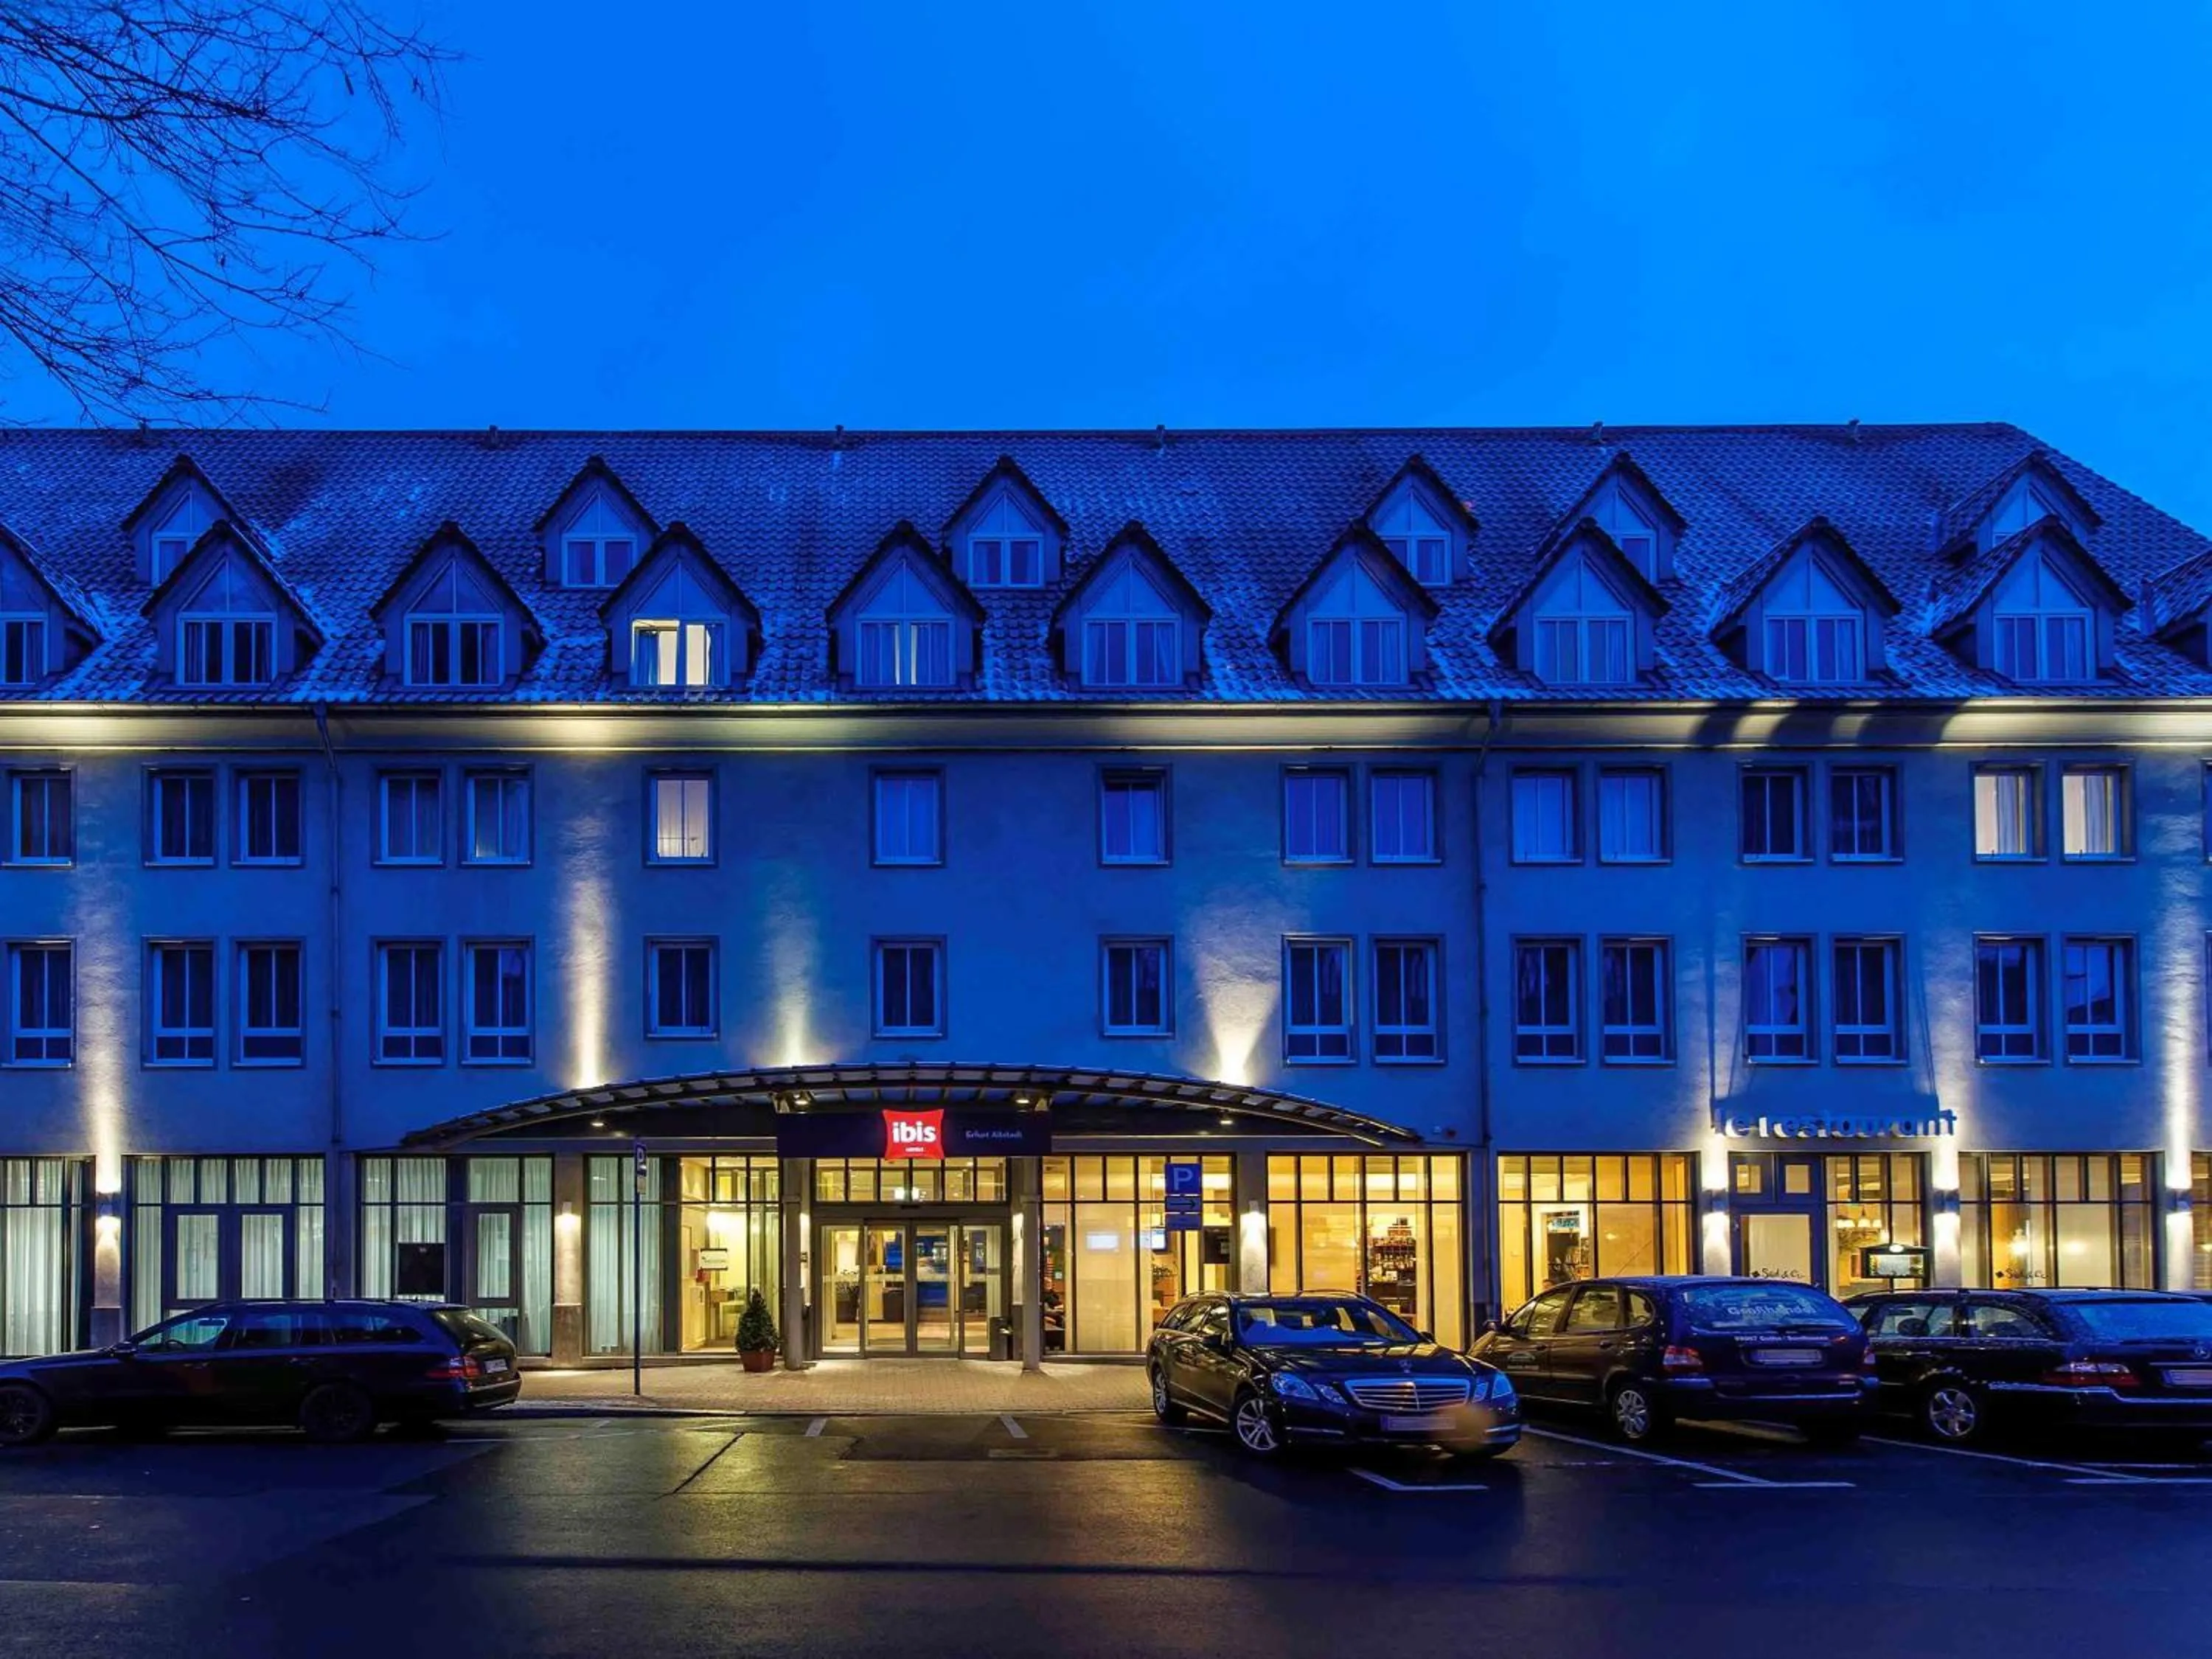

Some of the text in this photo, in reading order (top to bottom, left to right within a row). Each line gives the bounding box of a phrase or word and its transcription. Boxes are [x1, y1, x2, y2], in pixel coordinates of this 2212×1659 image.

[892, 1121, 936, 1143] ibis
[1765, 1109, 1958, 1137] restaurant
[1173, 1167, 1194, 1191] P
